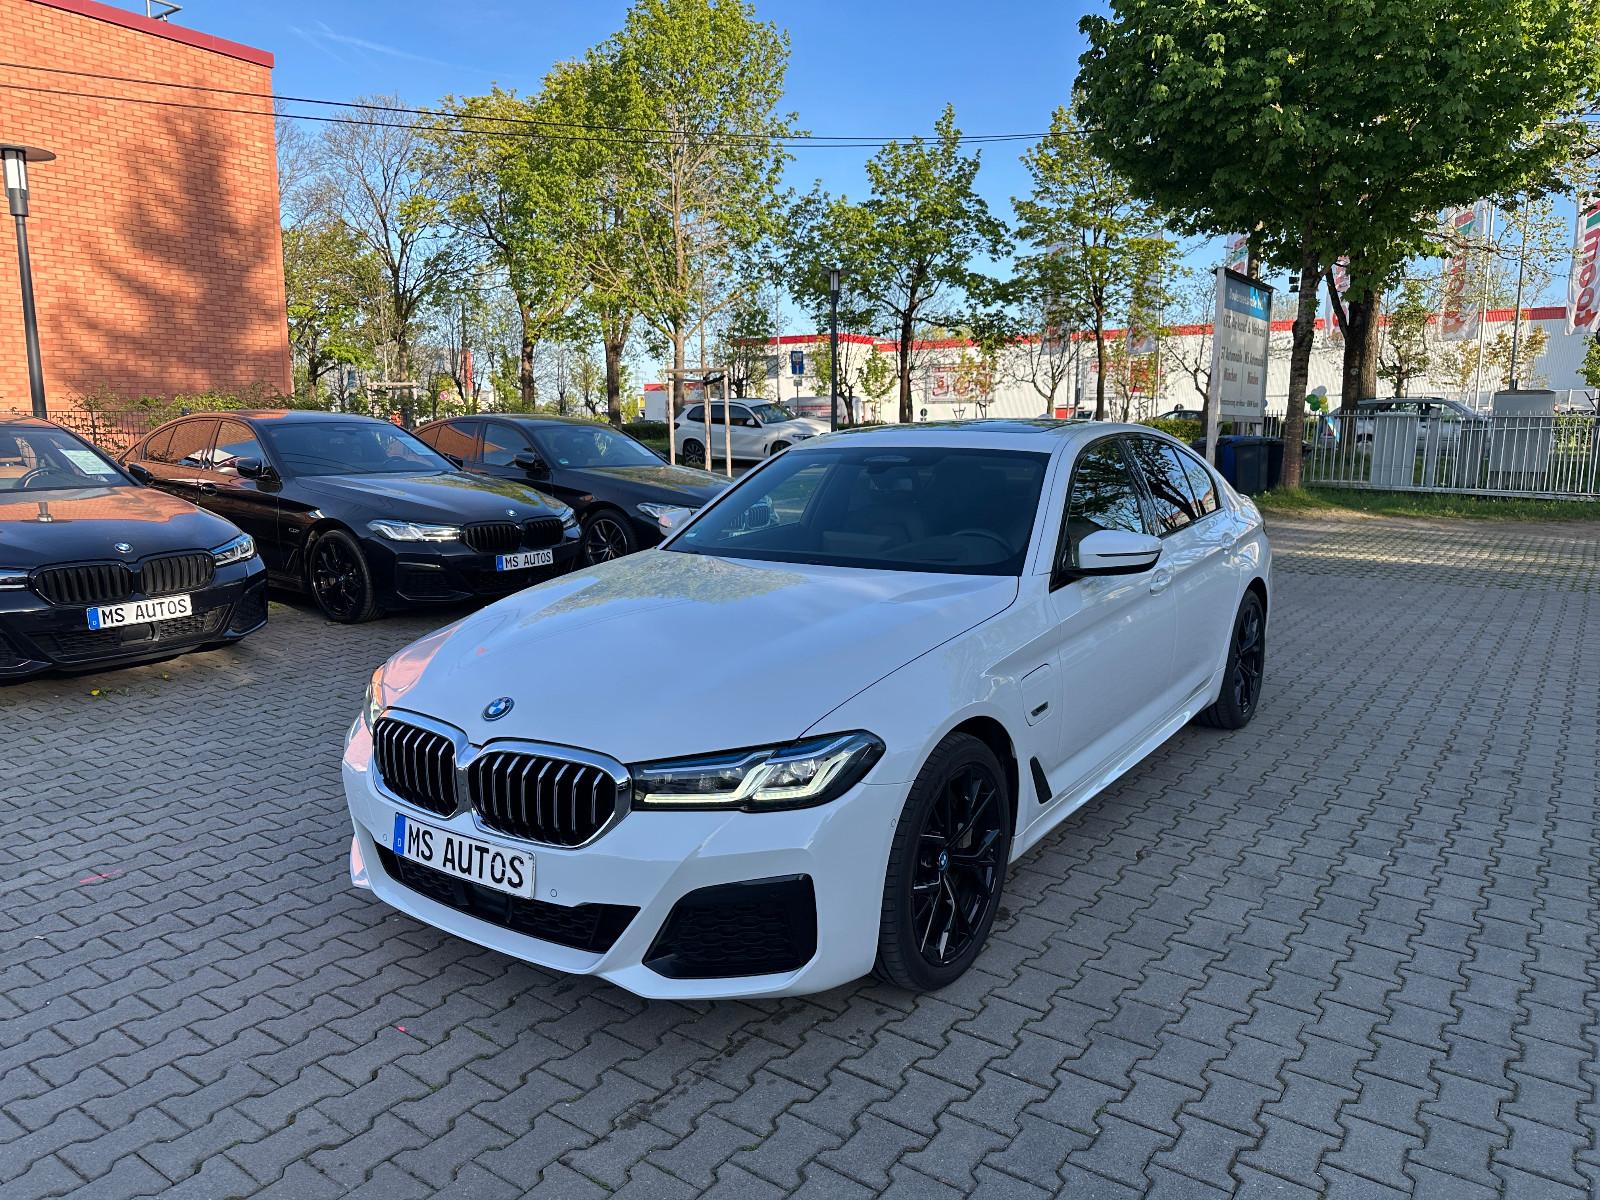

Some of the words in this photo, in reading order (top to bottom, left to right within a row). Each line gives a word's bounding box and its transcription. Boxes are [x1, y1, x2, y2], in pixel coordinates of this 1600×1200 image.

[505, 556, 519, 568] MS
[523, 551, 551, 567] AUTOS
[101, 607, 125, 625] MS
[135, 598, 187, 620] AUTOS
[407, 823, 434, 862] MS
[442, 837, 525, 889] AUTOS
